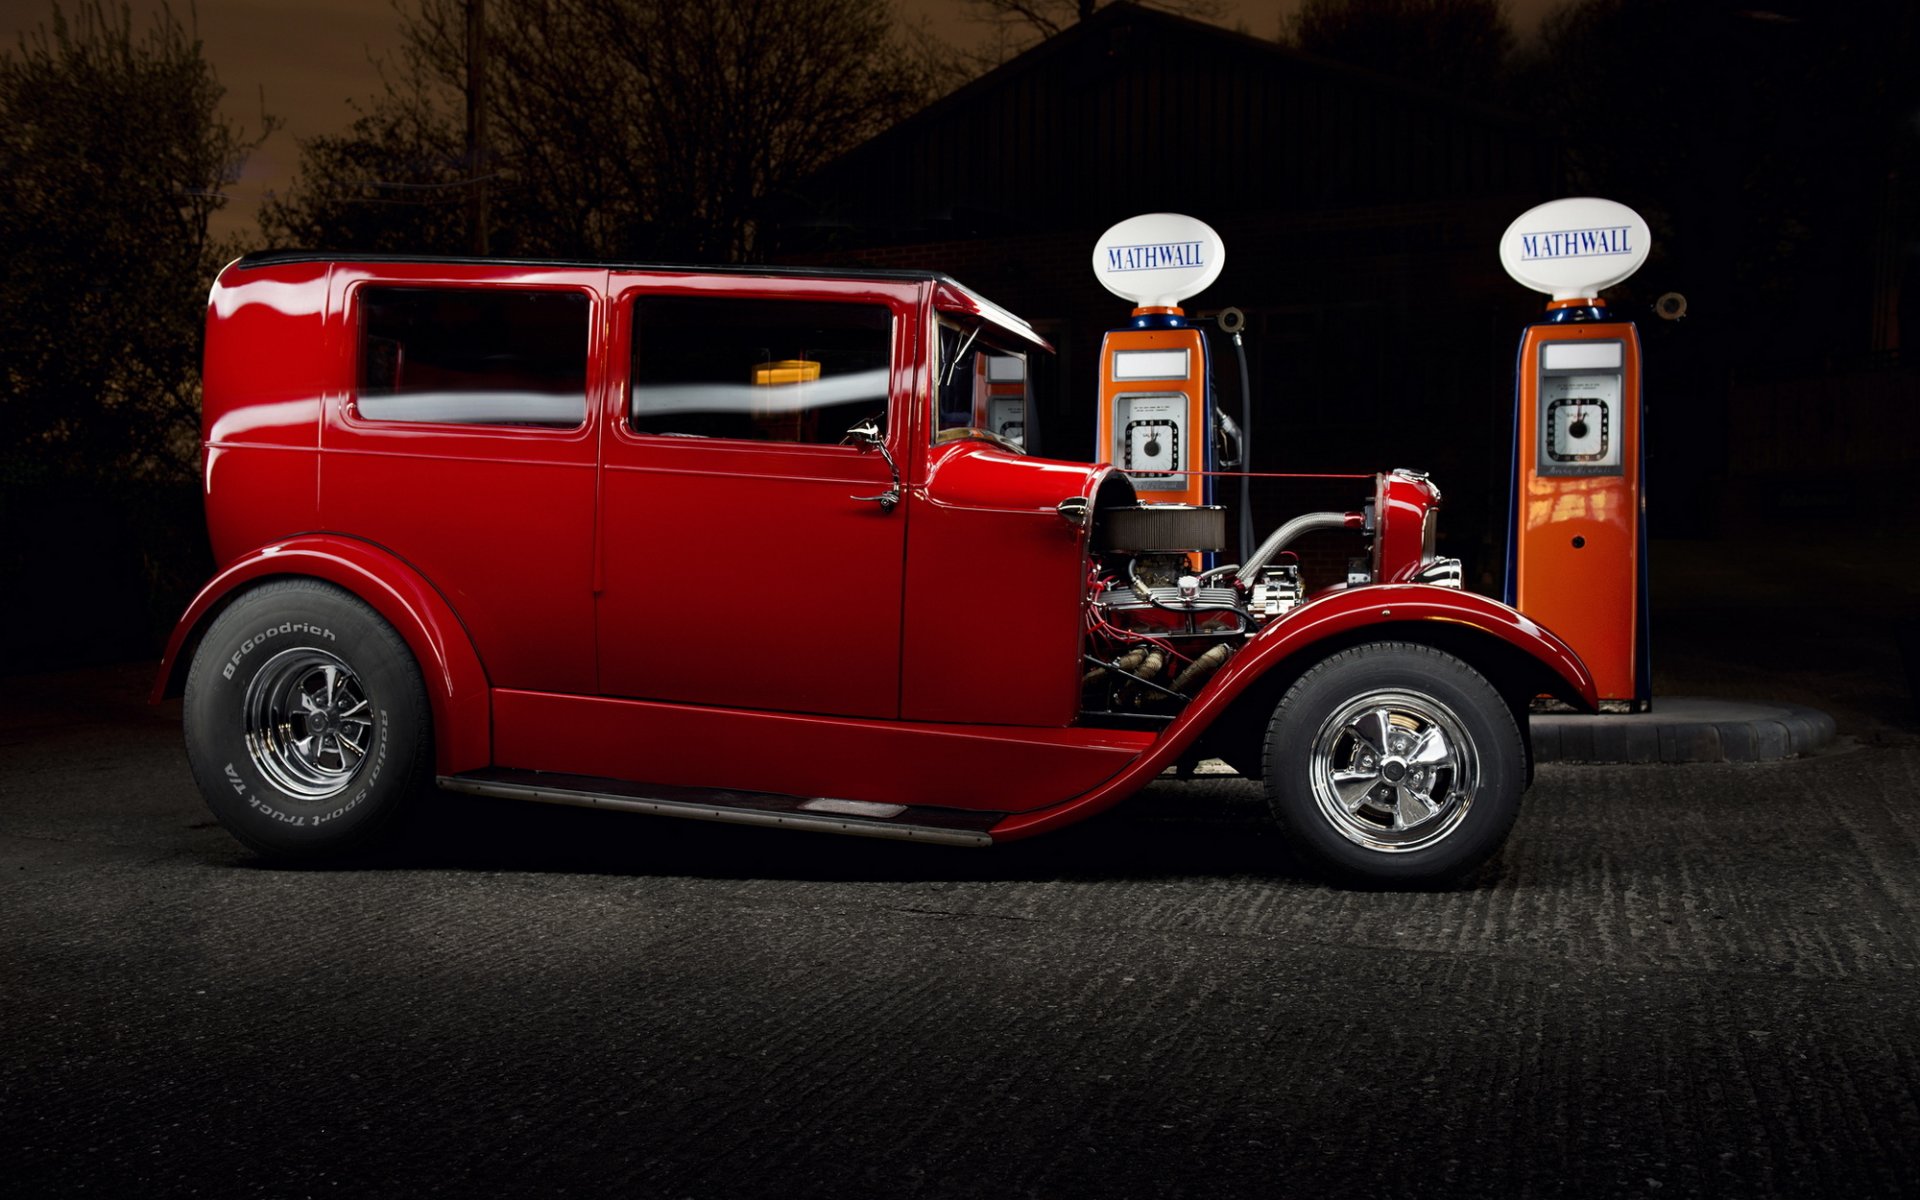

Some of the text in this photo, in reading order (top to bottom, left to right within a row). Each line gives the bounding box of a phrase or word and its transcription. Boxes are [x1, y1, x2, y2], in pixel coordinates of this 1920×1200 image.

[1107, 244, 1204, 270] MATHWALL
[1522, 229, 1632, 258] MATHWALL
[222, 621, 336, 680] BFGoodrich
[224, 709, 388, 826] Radial Sport Truck T/A
